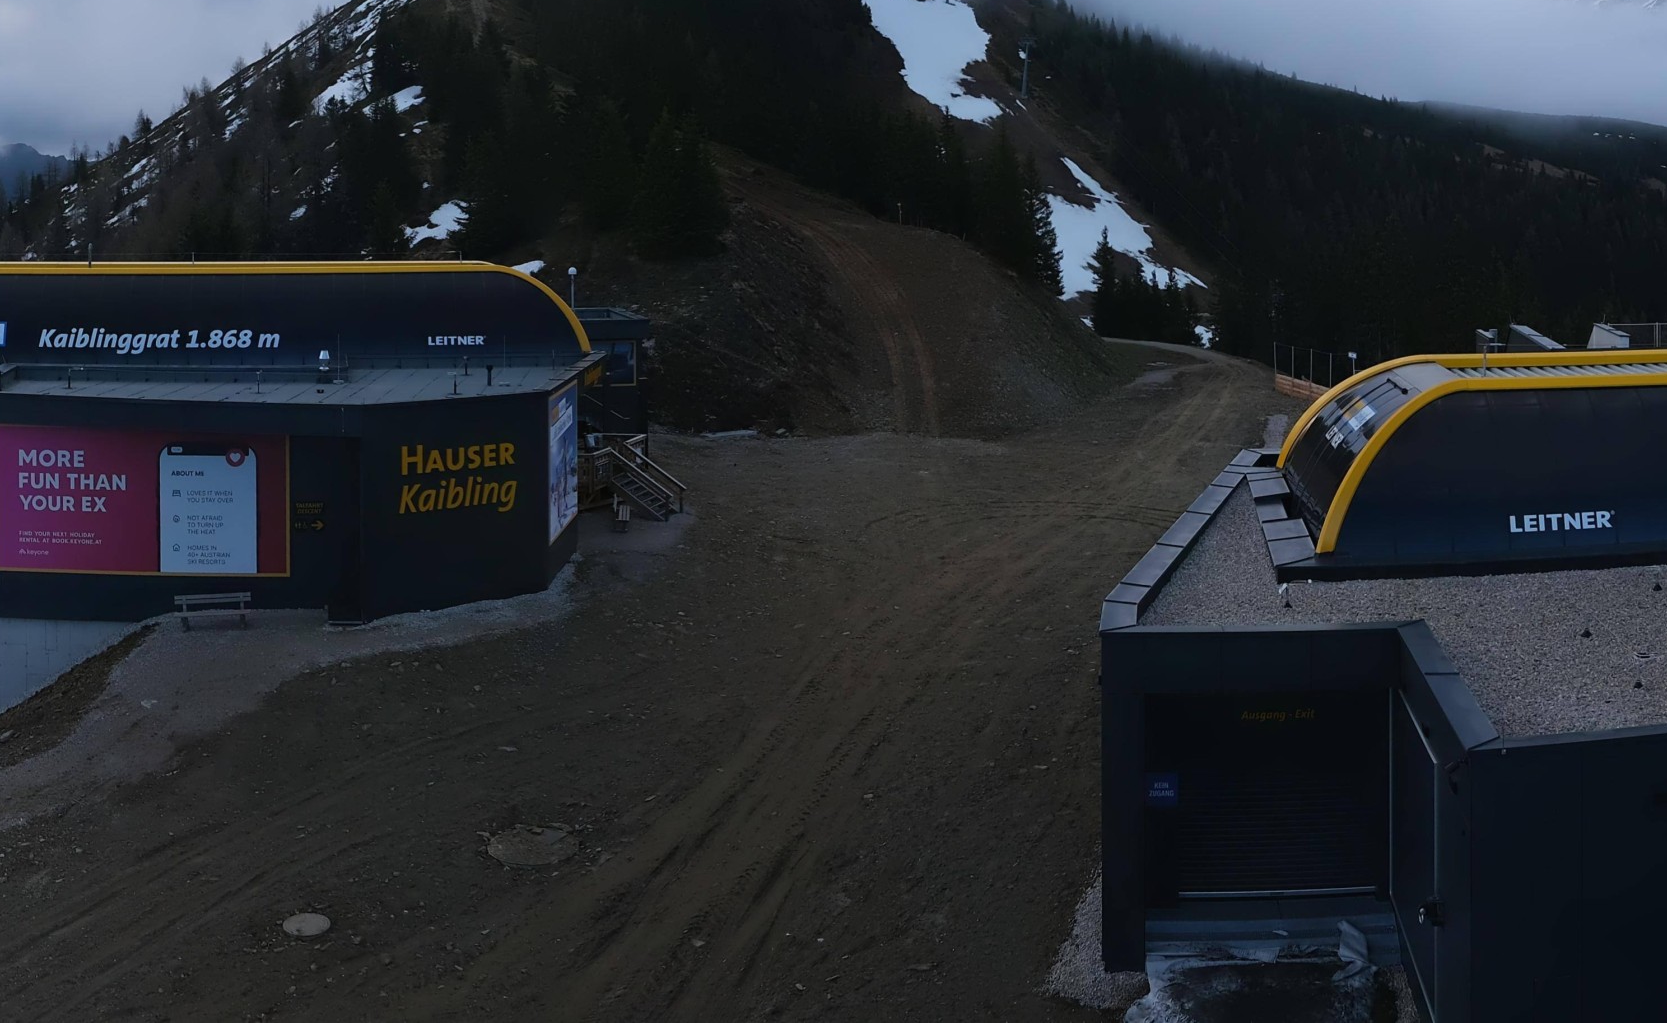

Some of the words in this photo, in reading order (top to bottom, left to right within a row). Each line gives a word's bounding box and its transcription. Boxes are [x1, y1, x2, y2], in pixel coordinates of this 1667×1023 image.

[38, 328, 180, 355] Kaiblinggrat
[185, 329, 252, 349] 1.868
[257, 333, 281, 348] m
[427, 335, 485, 346] LEITNER
[18, 449, 85, 468] MORE
[400, 442, 516, 476] HAUSER
[18, 472, 60, 490] FUN
[66, 473, 126, 491] THAN
[20, 494, 75, 512] YOUR
[81, 496, 107, 513] EX
[398, 475, 518, 514] Kaibling
[1509, 510, 1613, 533] LEITNER
[27, 548, 49, 556] keyone
[1240, 709, 1286, 722] Ausgang
[1294, 708, 1316, 720] Exit
